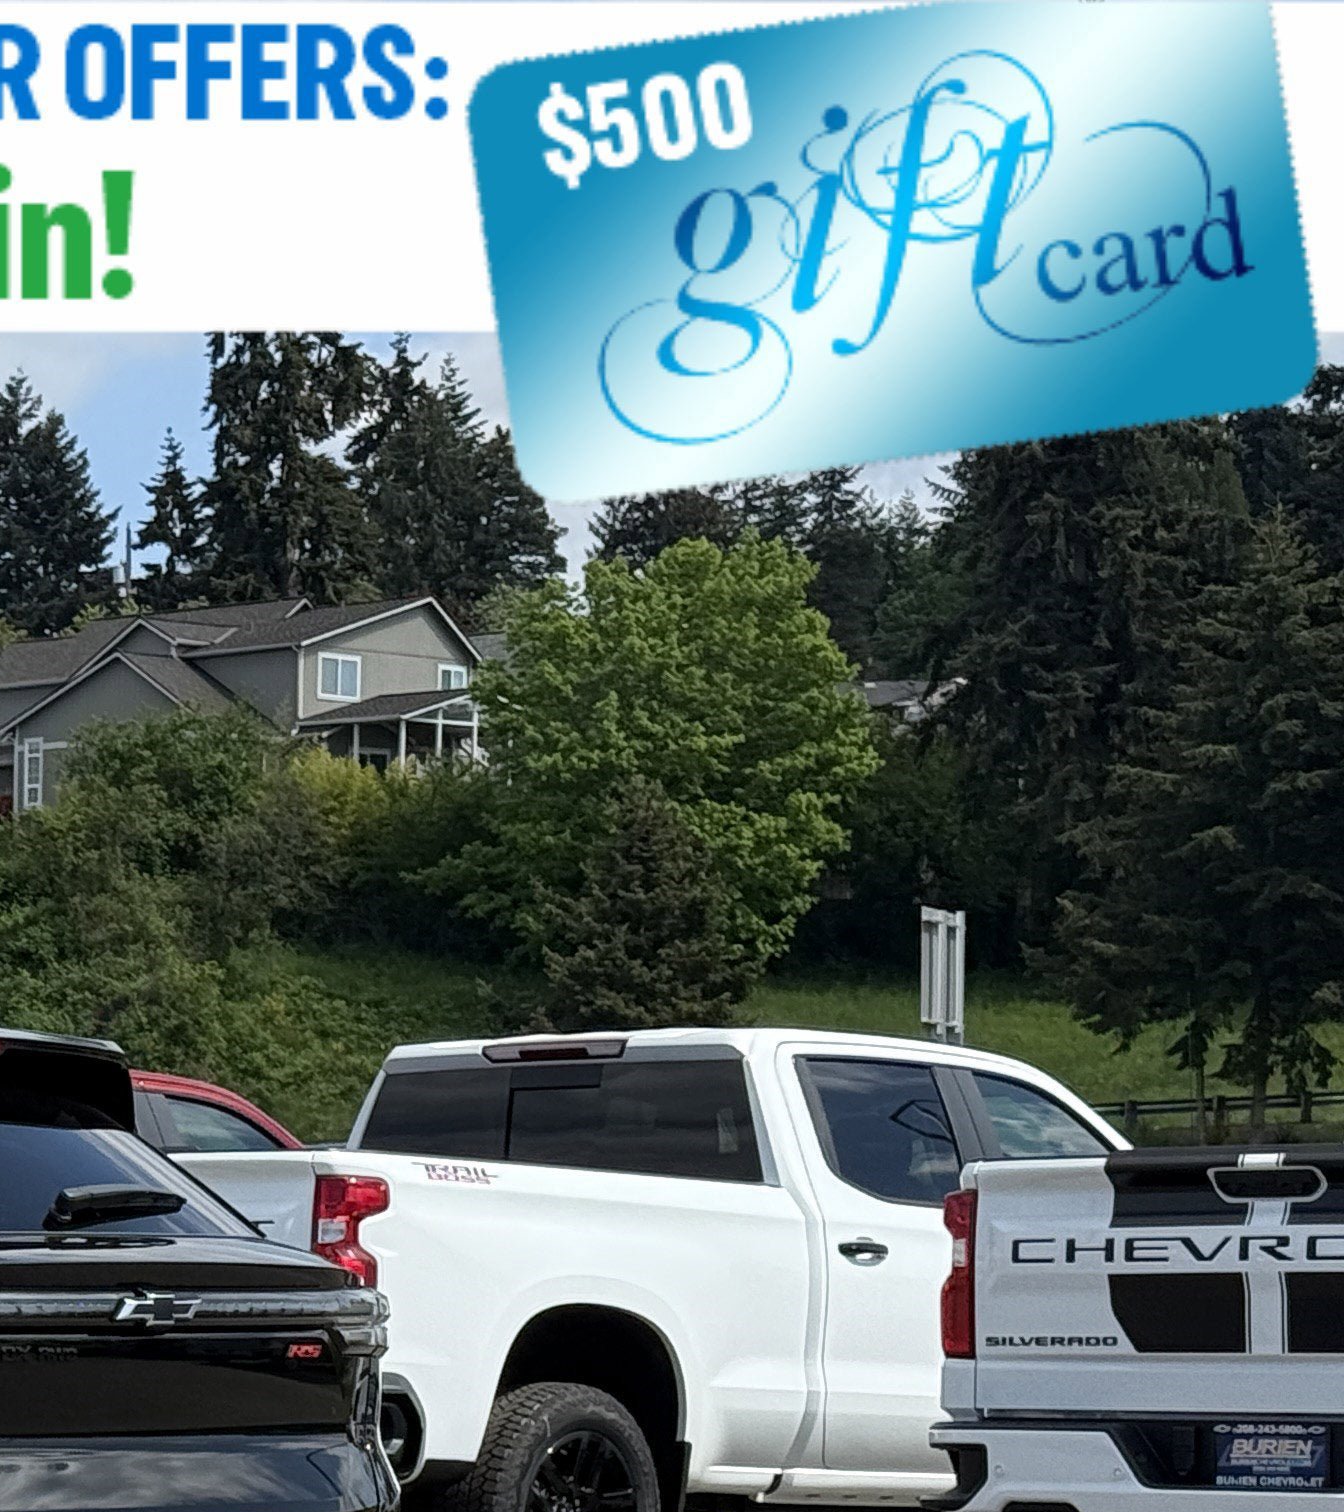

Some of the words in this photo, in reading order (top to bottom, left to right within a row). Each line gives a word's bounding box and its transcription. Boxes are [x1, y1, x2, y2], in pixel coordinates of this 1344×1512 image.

[411, 1161, 499, 1179] TRAIL
[985, 1336, 1119, 1348] SILVERADO
[285, 1344, 323, 1358] RS
[1231, 1438, 1313, 1455] BURIEN
[1215, 1475, 1257, 1487] BURIEN
[1259, 1475, 1325, 1488] CHEVROLET
